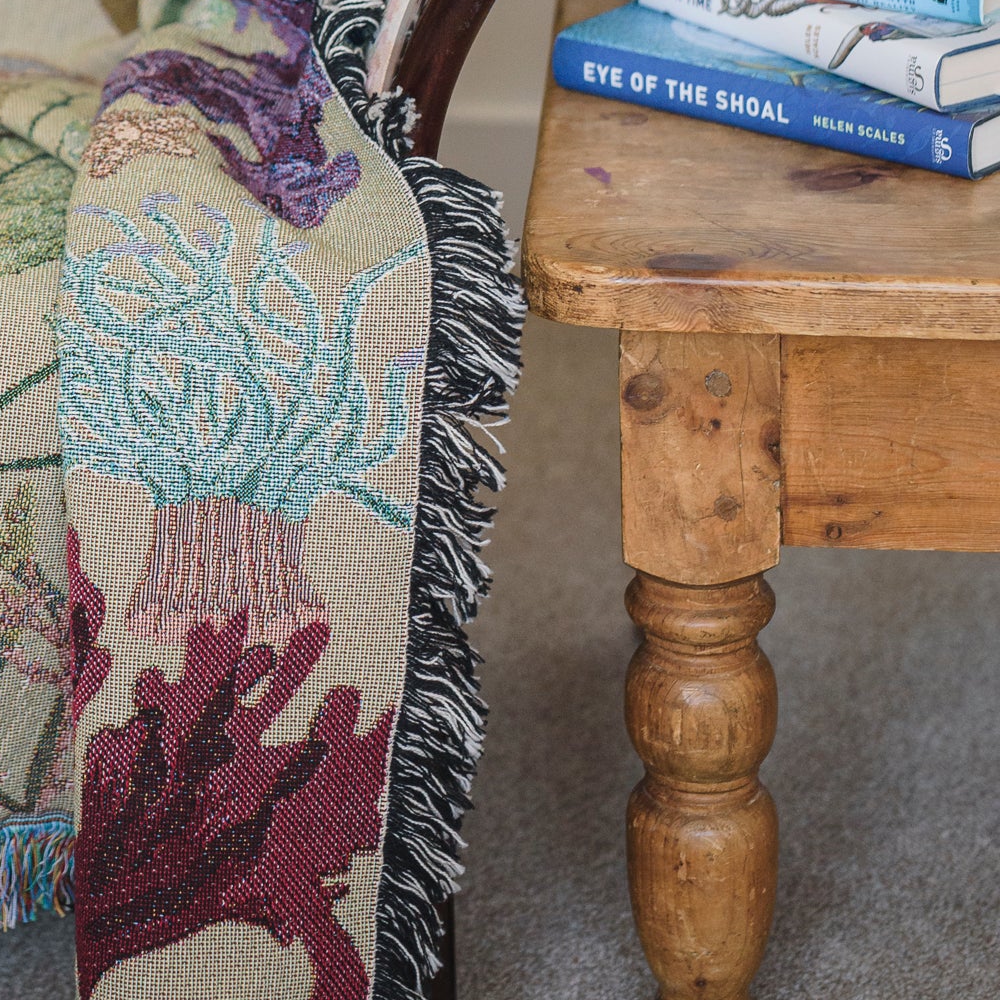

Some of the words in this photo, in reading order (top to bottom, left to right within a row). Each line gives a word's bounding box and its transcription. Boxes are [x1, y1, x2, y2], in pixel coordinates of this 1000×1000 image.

[583, 61, 623, 89] EYE
[630, 71, 658, 95] OF
[665, 78, 708, 107] THE
[716, 89, 790, 125] SHOAL
[813, 114, 854, 134] HELEN
[858, 124, 906, 146] SCALES
[934, 129, 943, 165] sigma
